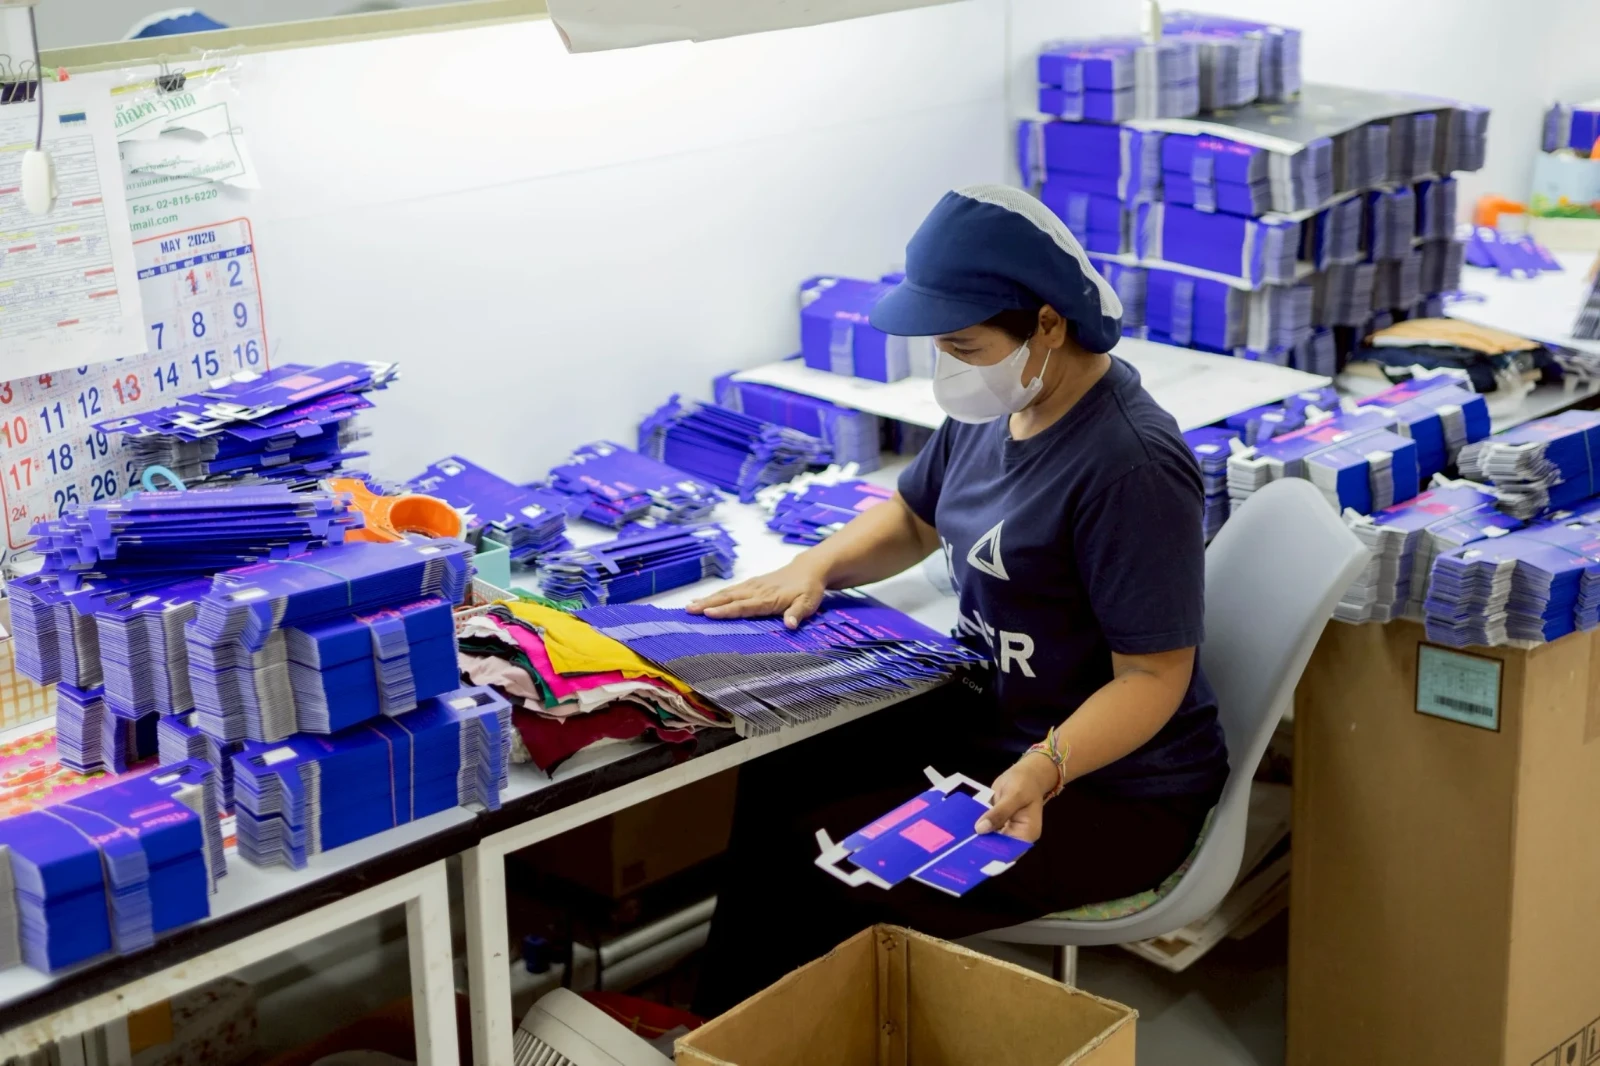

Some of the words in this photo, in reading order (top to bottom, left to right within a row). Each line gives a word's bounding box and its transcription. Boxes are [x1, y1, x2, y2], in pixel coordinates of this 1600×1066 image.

[132, 204, 154, 215] Fax.
[156, 188, 218, 210] 02-815-6220
[160, 238, 181, 254] MAY
[185, 269, 198, 295] 1
[228, 260, 243, 287] 2
[151, 322, 164, 350] 7
[192, 311, 206, 338] 8
[233, 302, 248, 328] 9
[2, 416, 28, 449] 10
[40, 402, 65, 433] 11
[78, 386, 101, 419] 12
[112, 374, 141, 405] 13
[154, 362, 179, 392] 14
[191, 350, 219, 380] 15
[233, 339, 259, 369] 16
[9, 457, 31, 491] 17
[47, 444, 73, 475] 18
[85, 431, 108, 460] 19
[12, 504, 27, 522] 24
[54, 484, 79, 519] 25
[91, 469, 117, 501] 26
